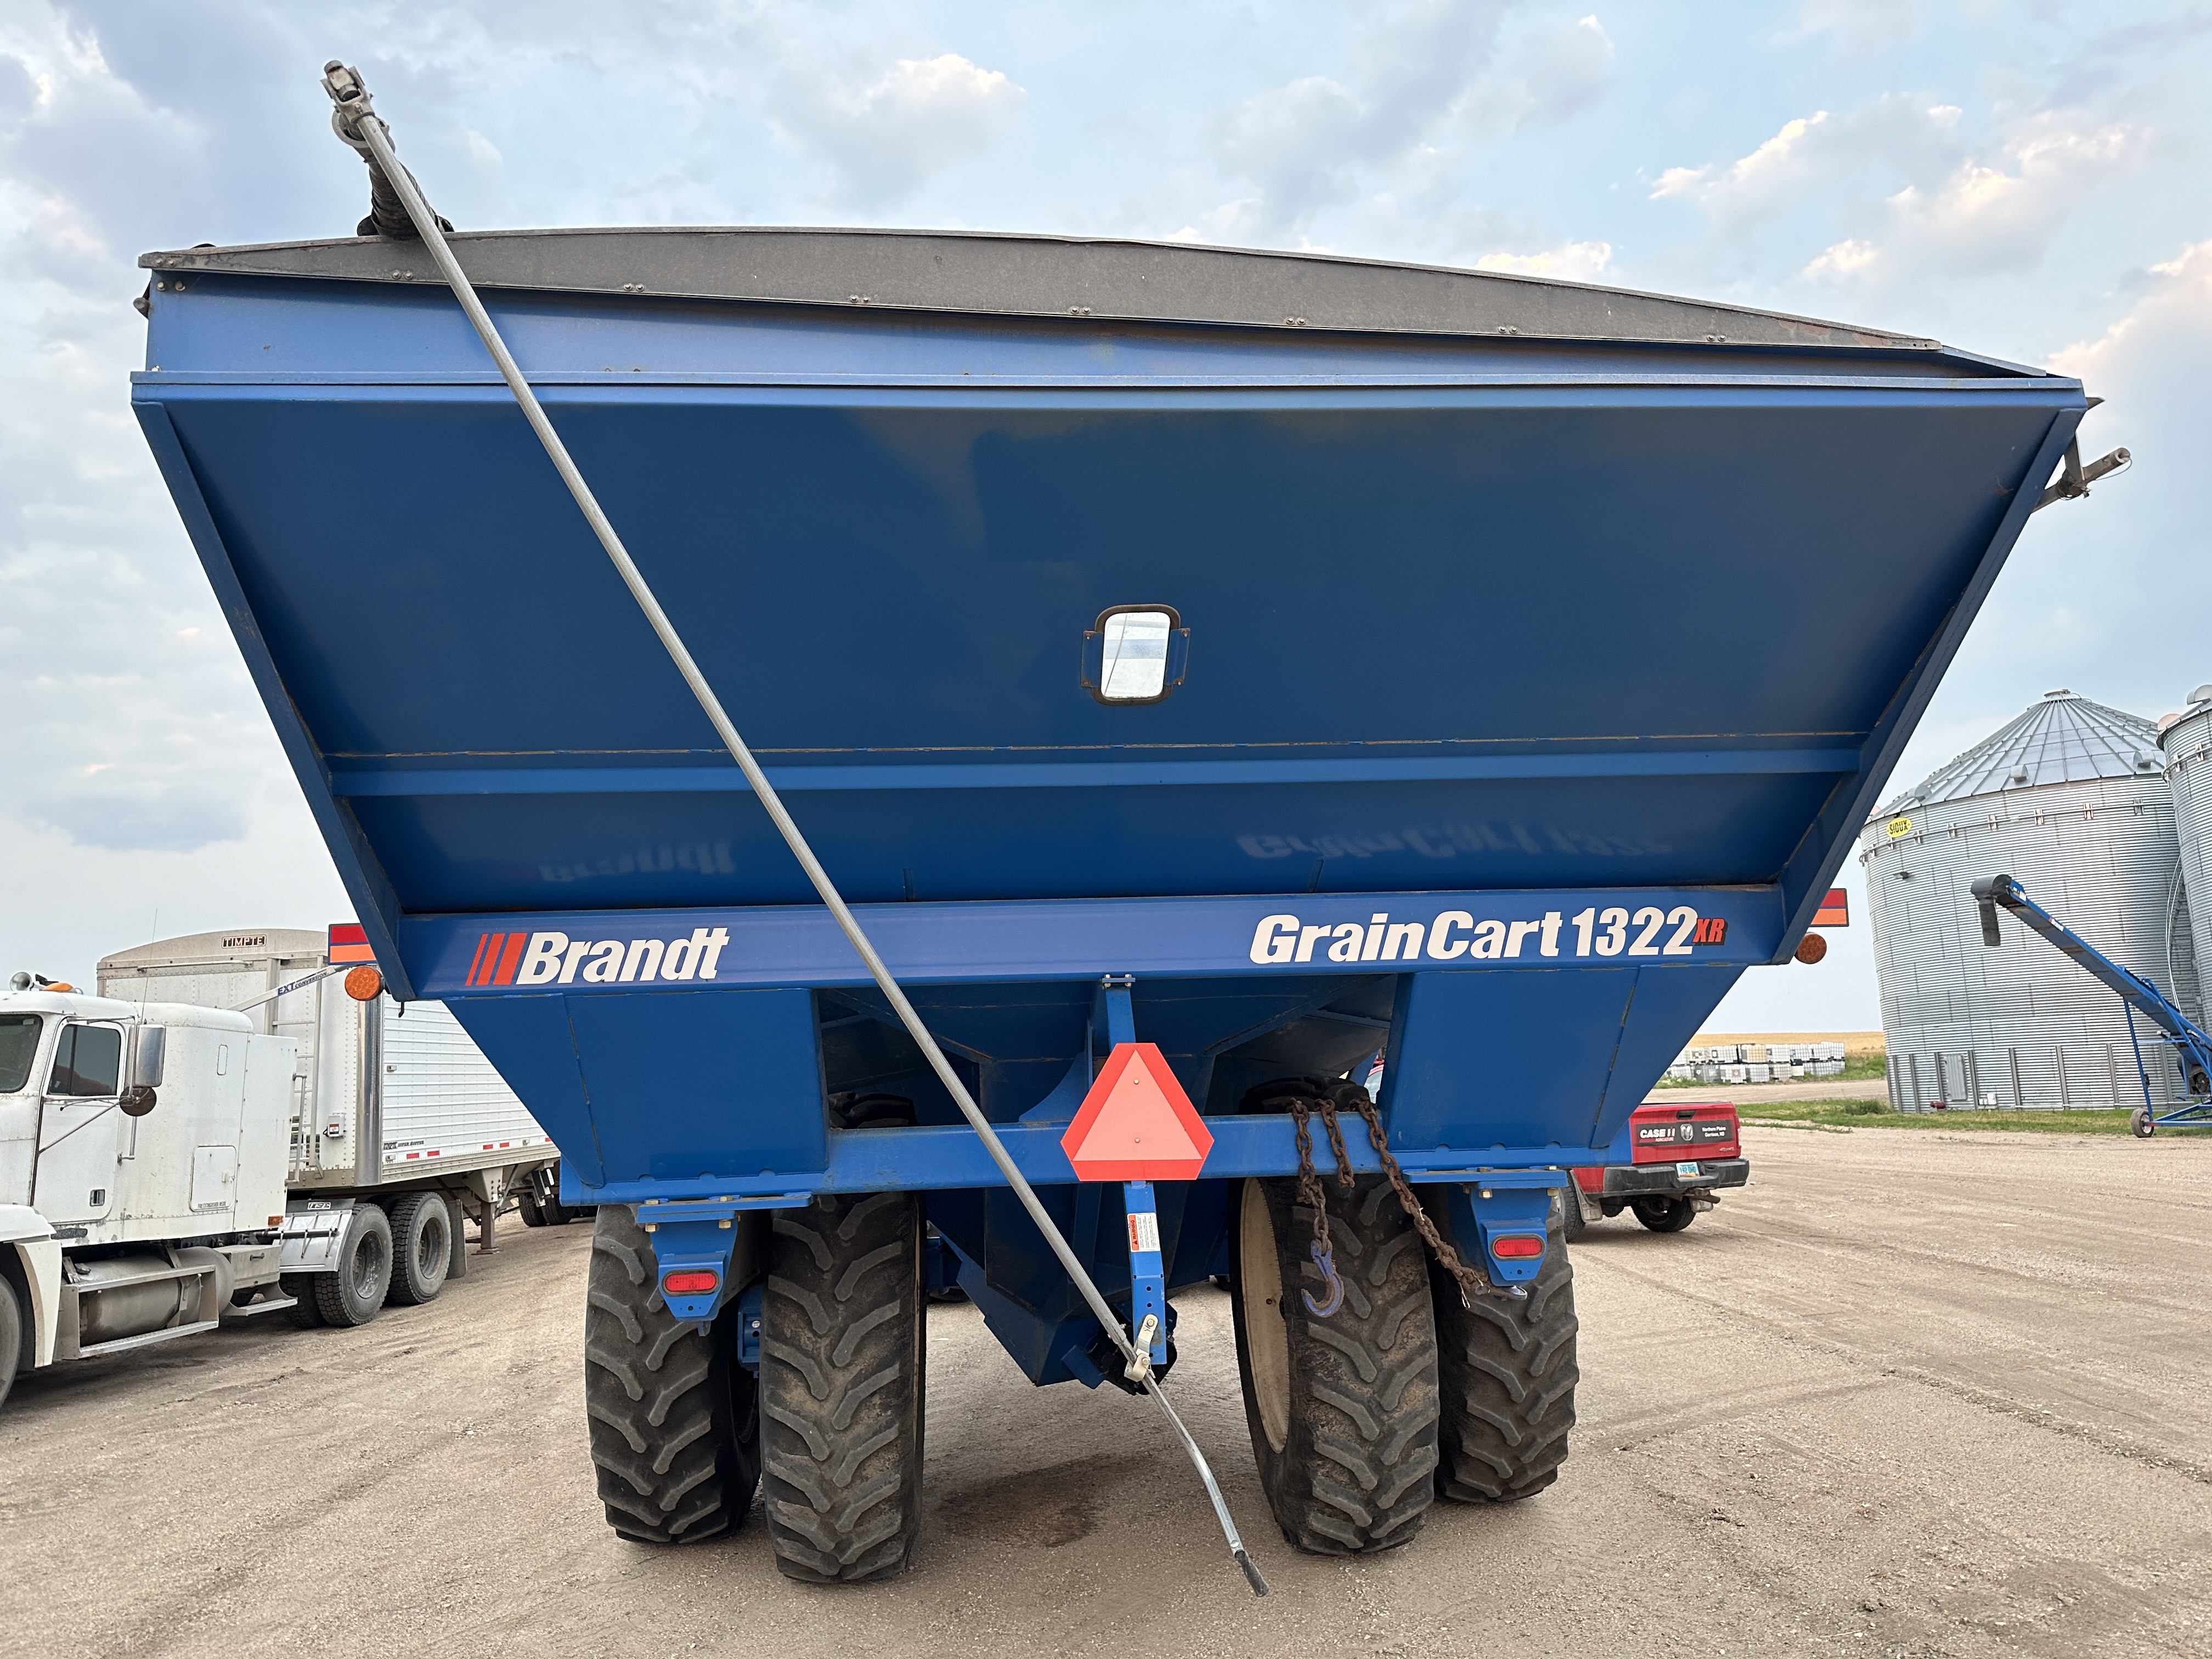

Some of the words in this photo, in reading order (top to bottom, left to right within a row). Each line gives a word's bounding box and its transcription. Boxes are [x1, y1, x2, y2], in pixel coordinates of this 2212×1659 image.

[1889, 820, 1908, 834] SIOUX
[1572, 906, 1698, 957] 1322
[1692, 917, 1728, 946] XR
[224, 936, 263, 947] TIMPTE
[515, 927, 730, 985] Brandt
[278, 981, 296, 996] EXT
[295, 972, 327, 988] CONVERSION
[1640, 1129, 1666, 1138] CASE
